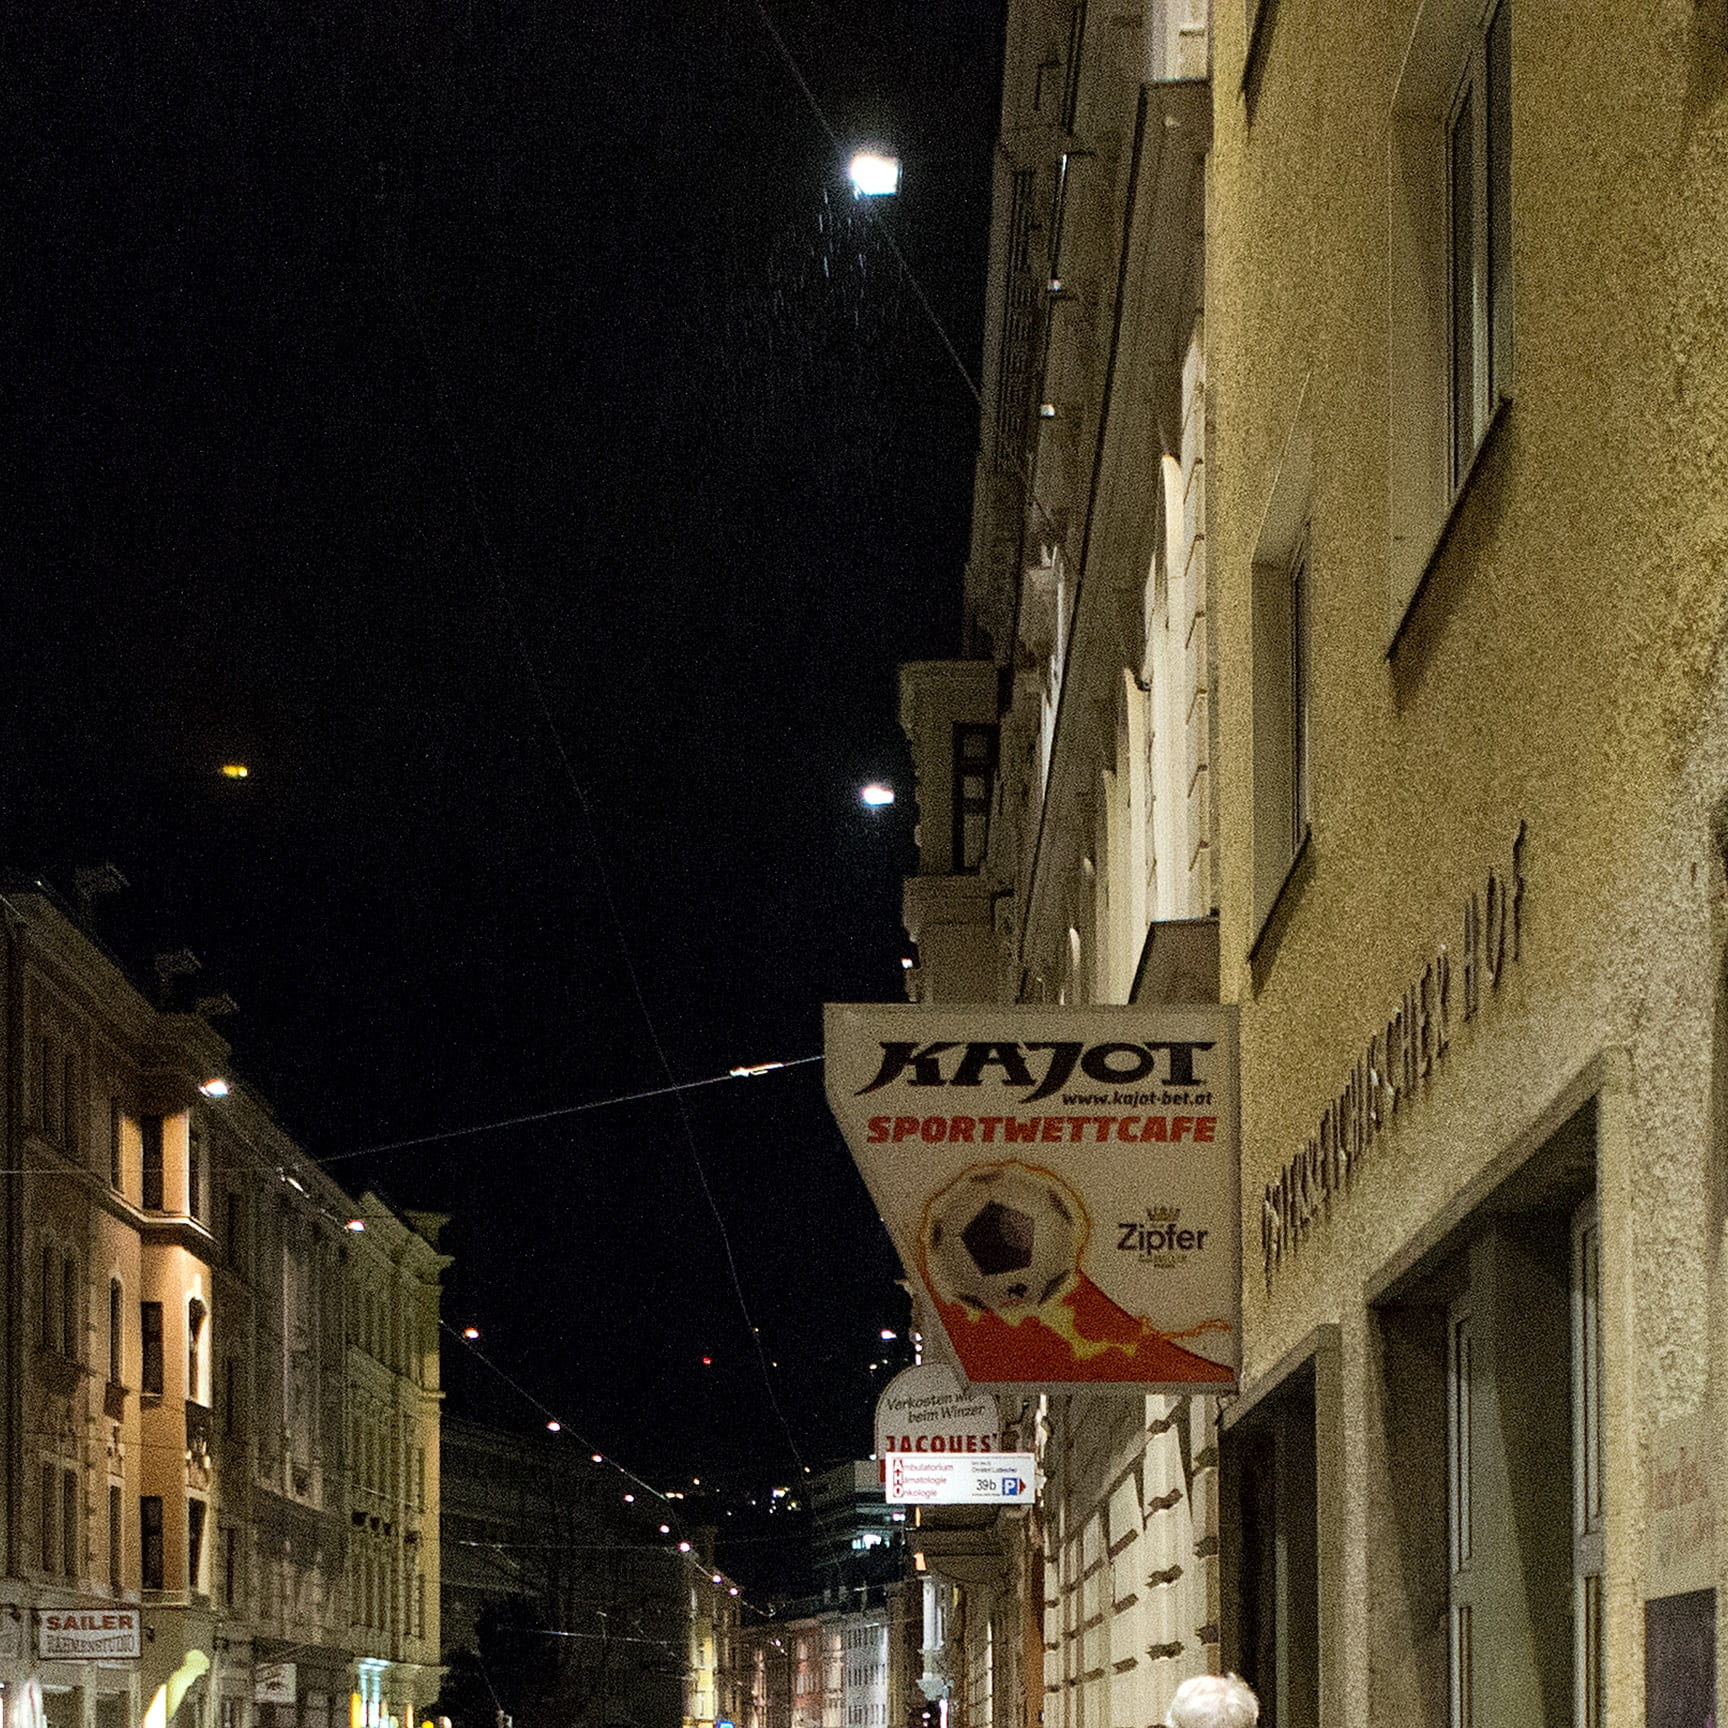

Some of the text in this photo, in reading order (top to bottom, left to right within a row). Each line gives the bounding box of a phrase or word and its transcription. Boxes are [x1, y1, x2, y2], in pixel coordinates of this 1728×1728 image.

[853, 1040, 1216, 1104] KAJOT
[1060, 1090, 1214, 1107] www.kajot-bet.at
[866, 1115, 1218, 1144] SPORTWETTCAFE
[1116, 1222, 1209, 1256] Zipfer
[886, 1394, 953, 1411] Verkosten
[908, 1405, 986, 1423] beim Winzer
[893, 1459, 954, 1472] Ambulatorium
[893, 1485, 938, 1500] Onkologie
[46, 1615, 134, 1631] SAILER
